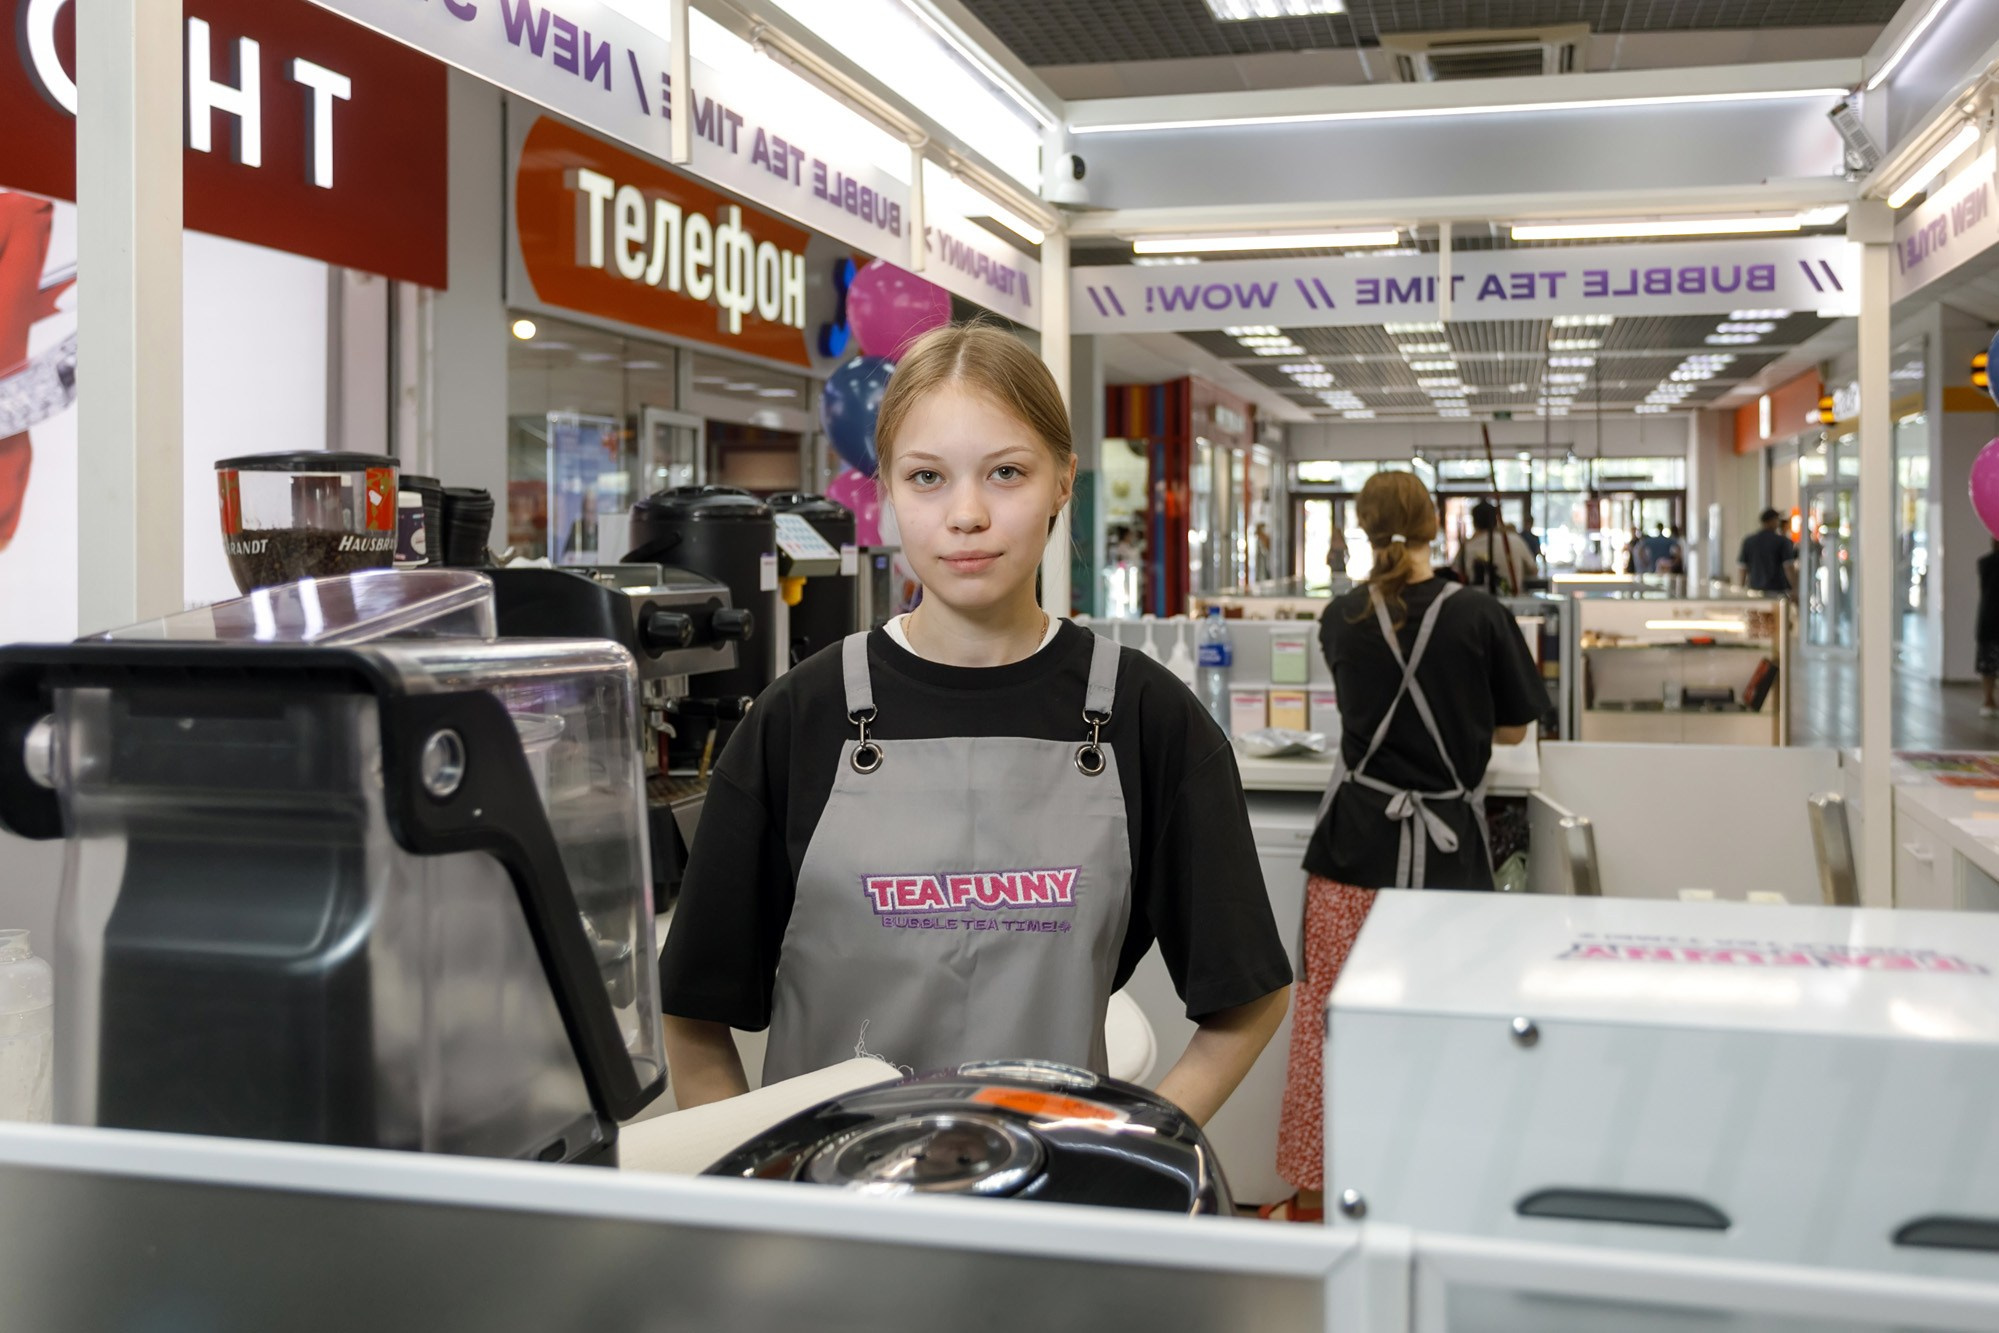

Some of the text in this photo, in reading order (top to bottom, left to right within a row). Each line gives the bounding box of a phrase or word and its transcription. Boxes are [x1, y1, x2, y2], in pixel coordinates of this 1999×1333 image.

[578, 168, 806, 335] телефон
[226, 539, 269, 556] RANDT
[867, 869, 1078, 911] TEA FUNNY
[881, 916, 1058, 933] BUBBLE TEA TIME!
